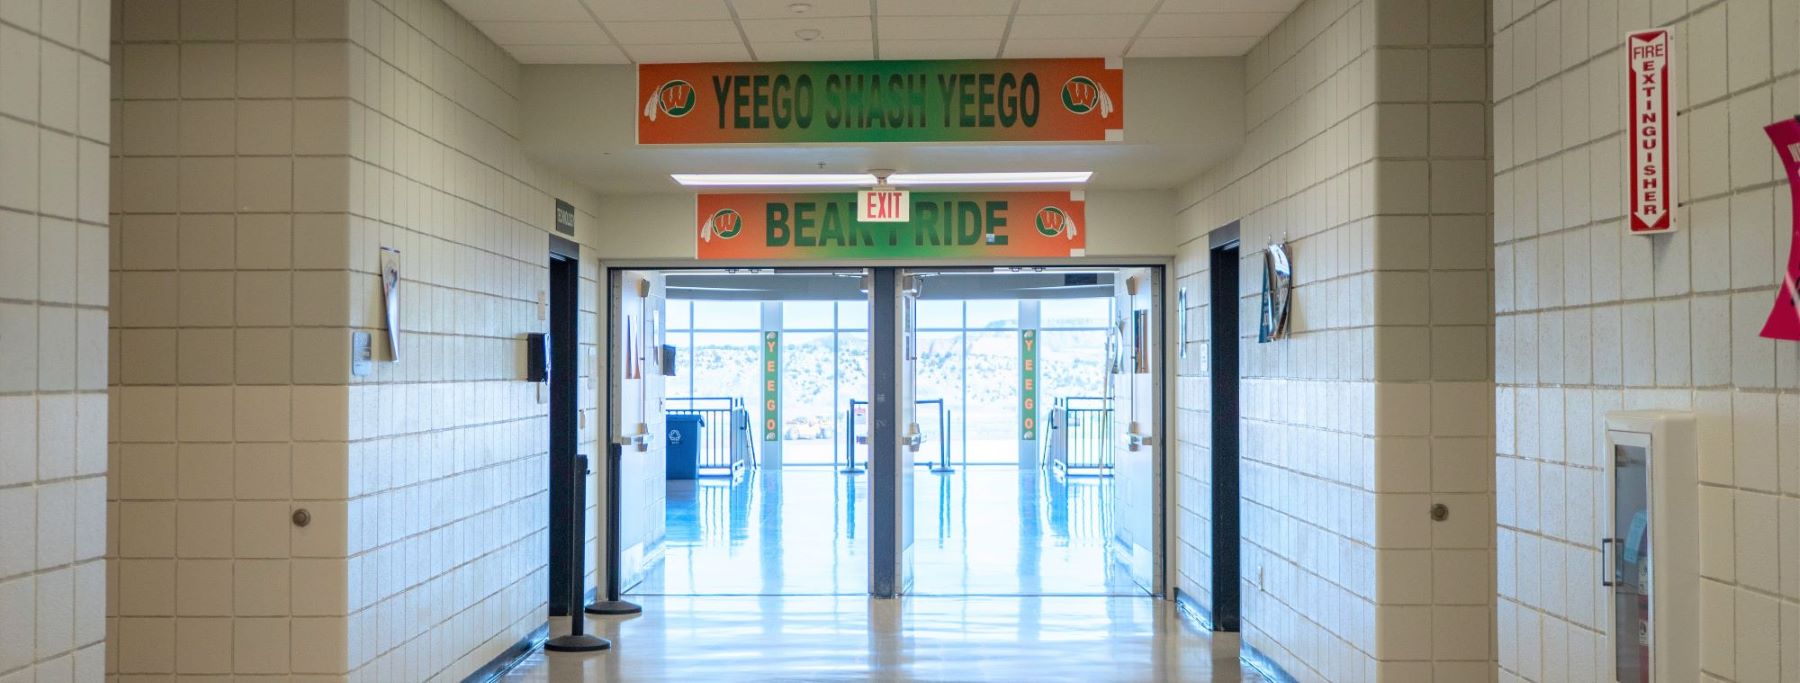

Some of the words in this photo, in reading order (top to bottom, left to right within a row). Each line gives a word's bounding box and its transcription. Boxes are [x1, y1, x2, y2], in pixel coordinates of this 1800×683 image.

[1633, 44, 1664, 60] FIRE
[712, 74, 814, 129] YEEGO
[825, 74, 926, 129] SHASH
[938, 72, 1040, 128] YEEGO
[1642, 61, 1657, 215] EXTINGUISHER
[867, 191, 902, 218] EXIT
[767, 341, 776, 430] YEEGO
[1024, 339, 1033, 430] YEEGO
